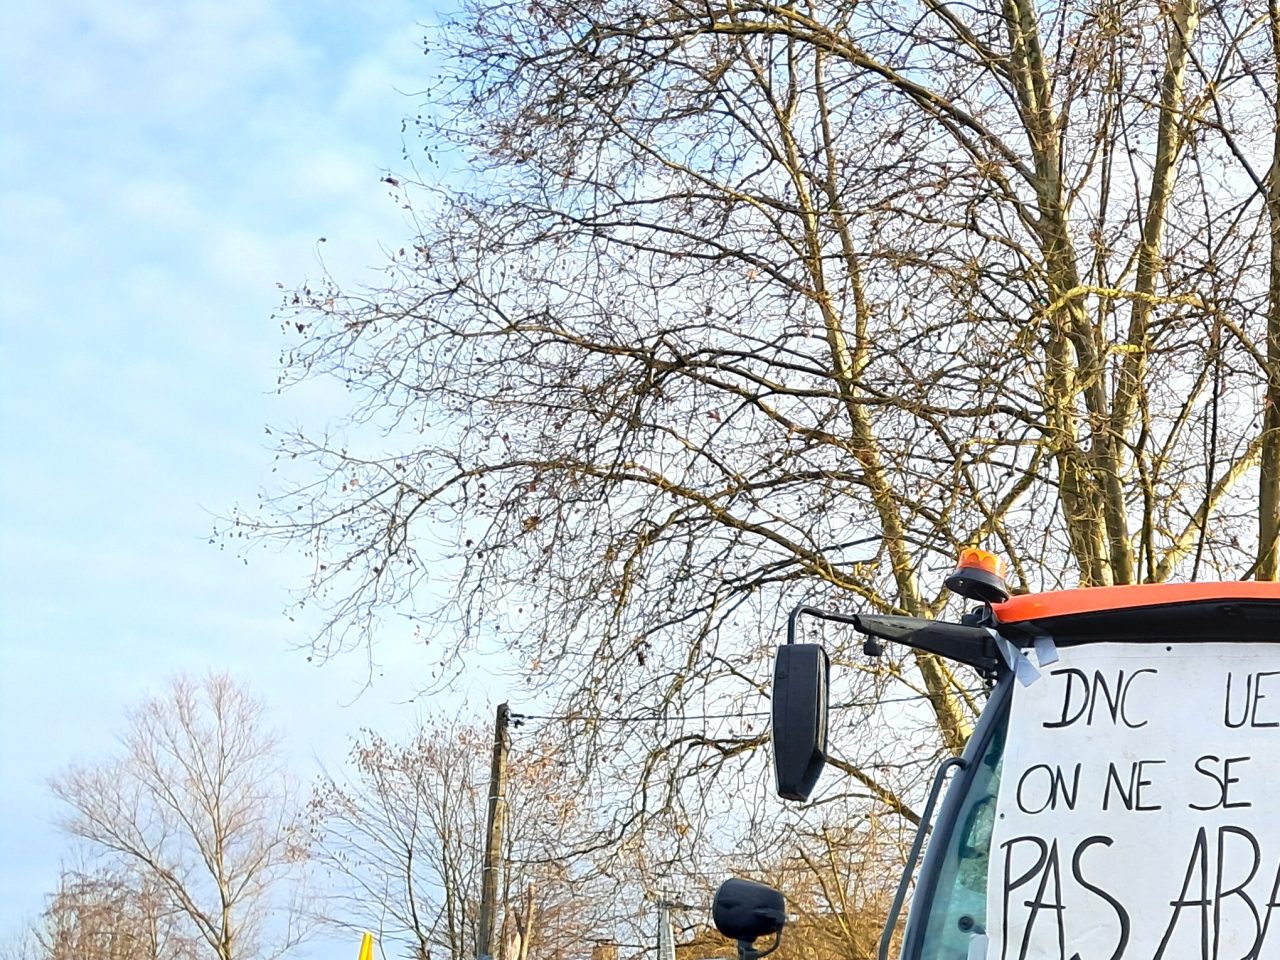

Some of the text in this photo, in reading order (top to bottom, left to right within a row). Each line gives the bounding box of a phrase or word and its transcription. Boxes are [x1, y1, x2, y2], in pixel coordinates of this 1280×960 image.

[1043, 668, 1157, 728] DNC
[1224, 671, 1280, 728] UE
[1016, 762, 1081, 814] ON
[1103, 760, 1166, 811] NE
[1189, 755, 1252, 810] SE
